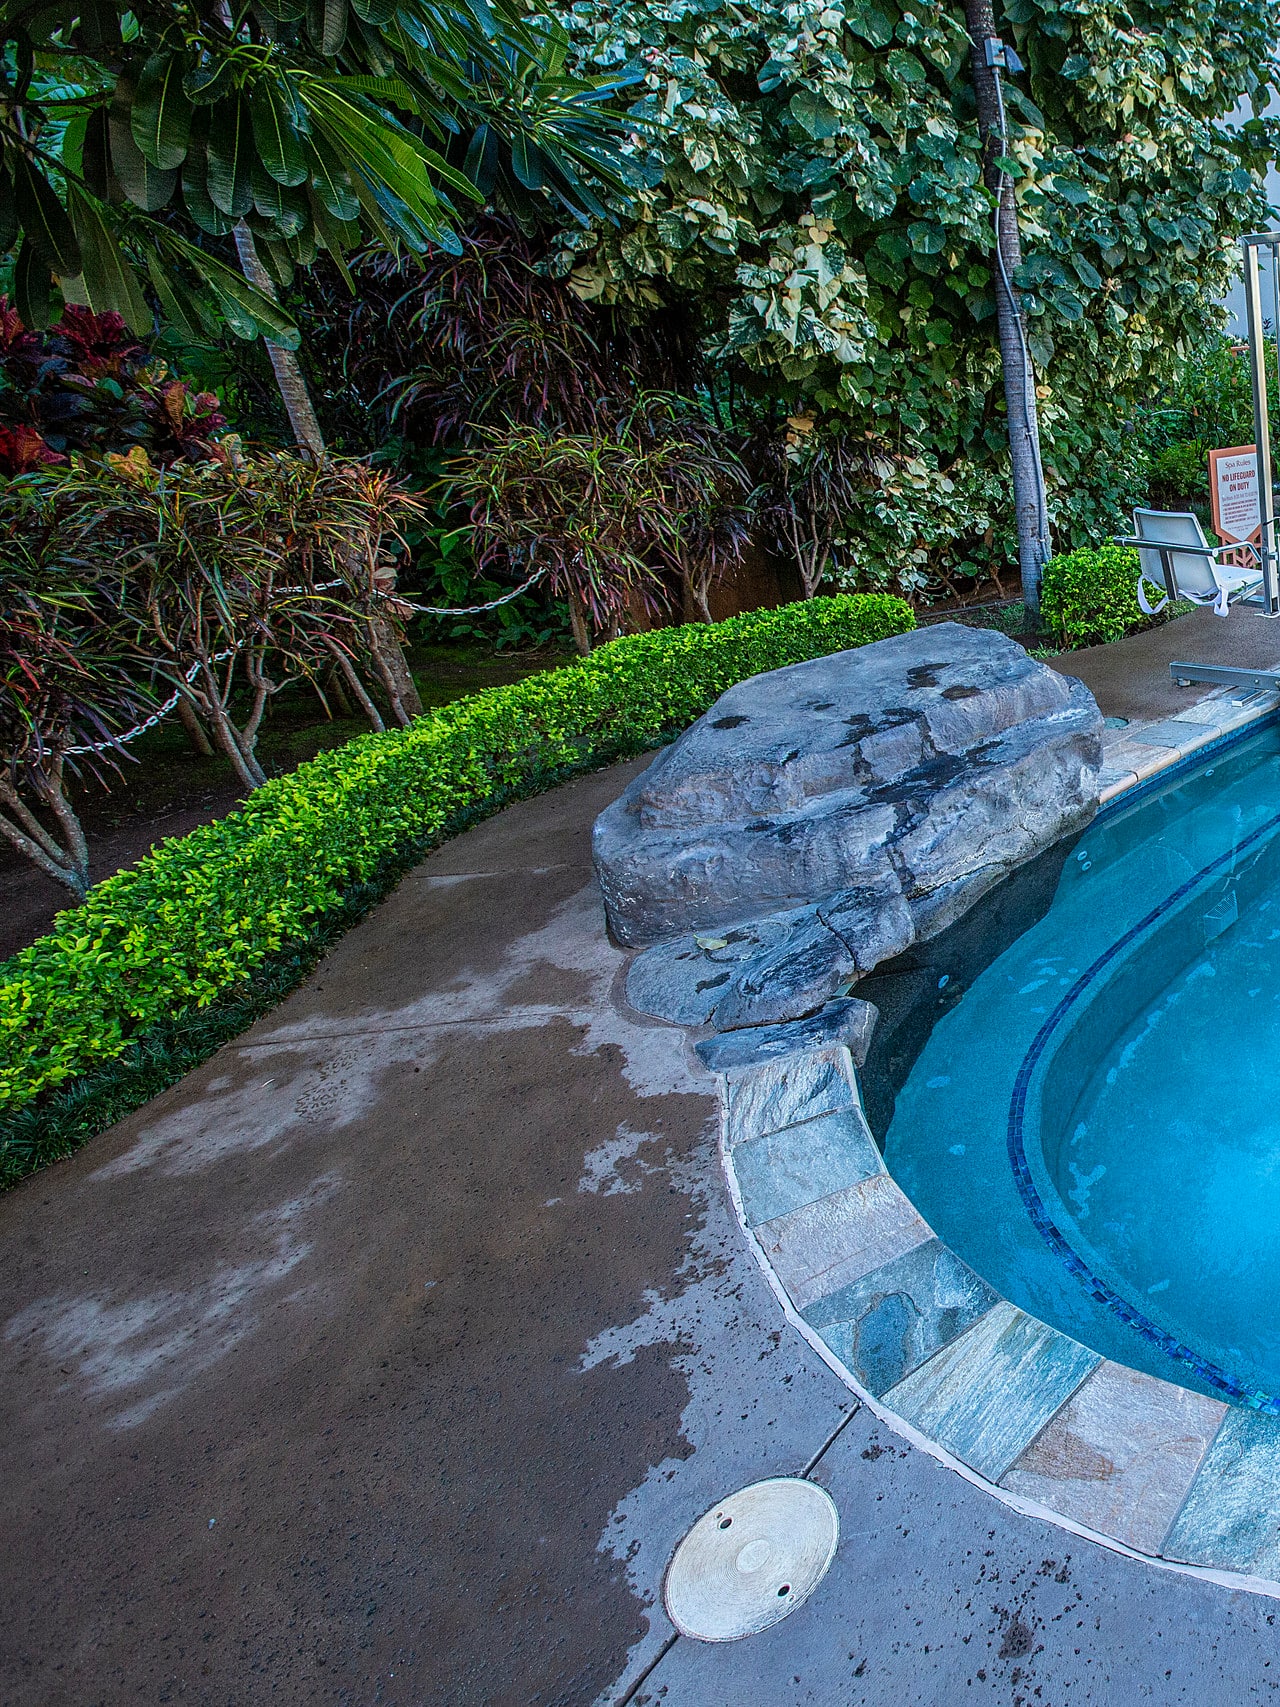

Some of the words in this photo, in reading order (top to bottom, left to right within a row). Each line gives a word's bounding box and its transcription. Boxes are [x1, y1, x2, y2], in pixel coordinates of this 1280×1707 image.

[1225, 461, 1235, 470] Spa
[1236, 459, 1251, 467] Rules
[1222, 474, 1229, 482] NO
[1230, 470, 1255, 481] LIFEGUARD
[1229, 484, 1236, 492] ON
[1237, 482, 1249, 491] DUTY
